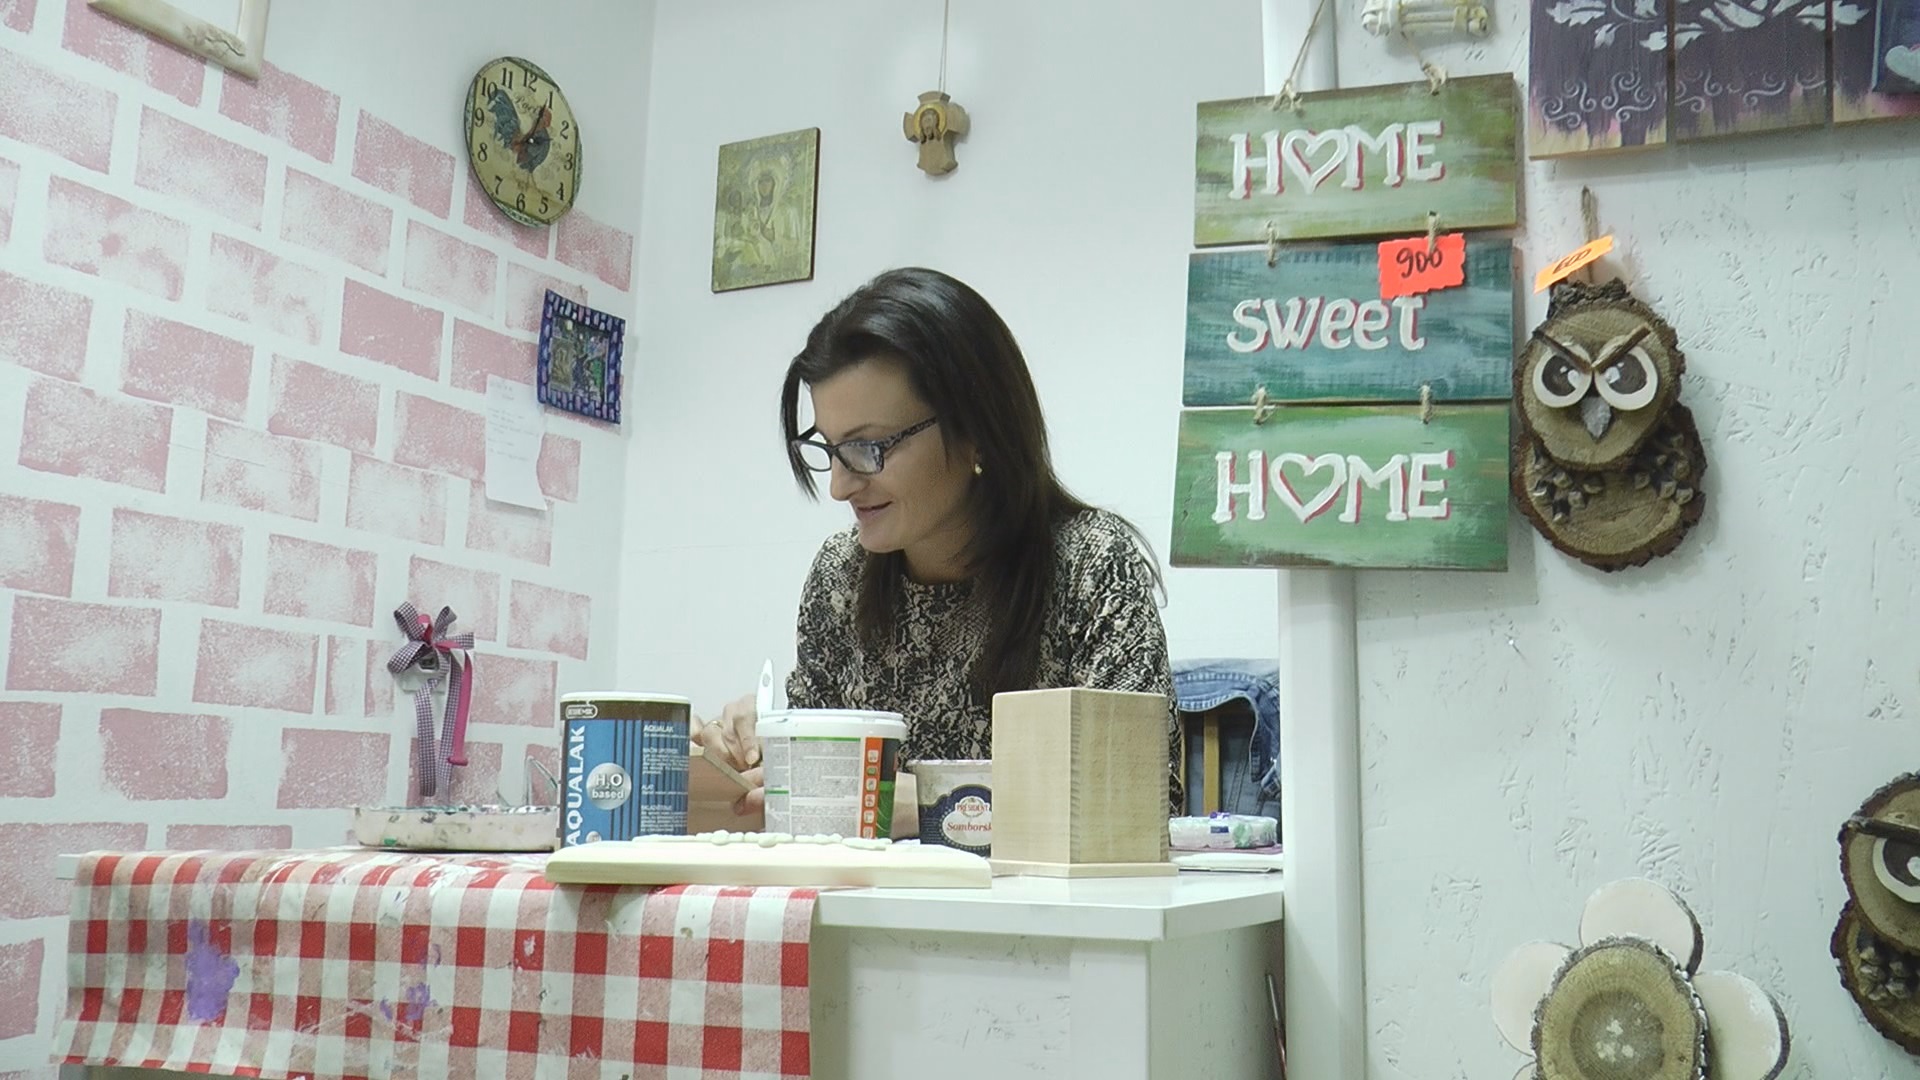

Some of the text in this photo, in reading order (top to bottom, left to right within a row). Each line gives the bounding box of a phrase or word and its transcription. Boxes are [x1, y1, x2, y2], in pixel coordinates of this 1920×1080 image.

[502, 68, 513, 90] 11
[523, 69, 538, 93] 12
[474, 107, 485, 127] 9
[559, 120, 570, 140] 2
[477, 142, 488, 163] 8
[564, 153, 573, 171] 3
[494, 174, 504, 196] 7
[556, 182, 564, 201] 4
[515, 192, 526, 213] 6
[539, 197, 548, 214] 5
[1396, 247, 1443, 278] 900
[1226, 296, 1428, 353] sweet
[566, 725, 586, 847] AQUALAK
[592, 789, 624, 799] based
